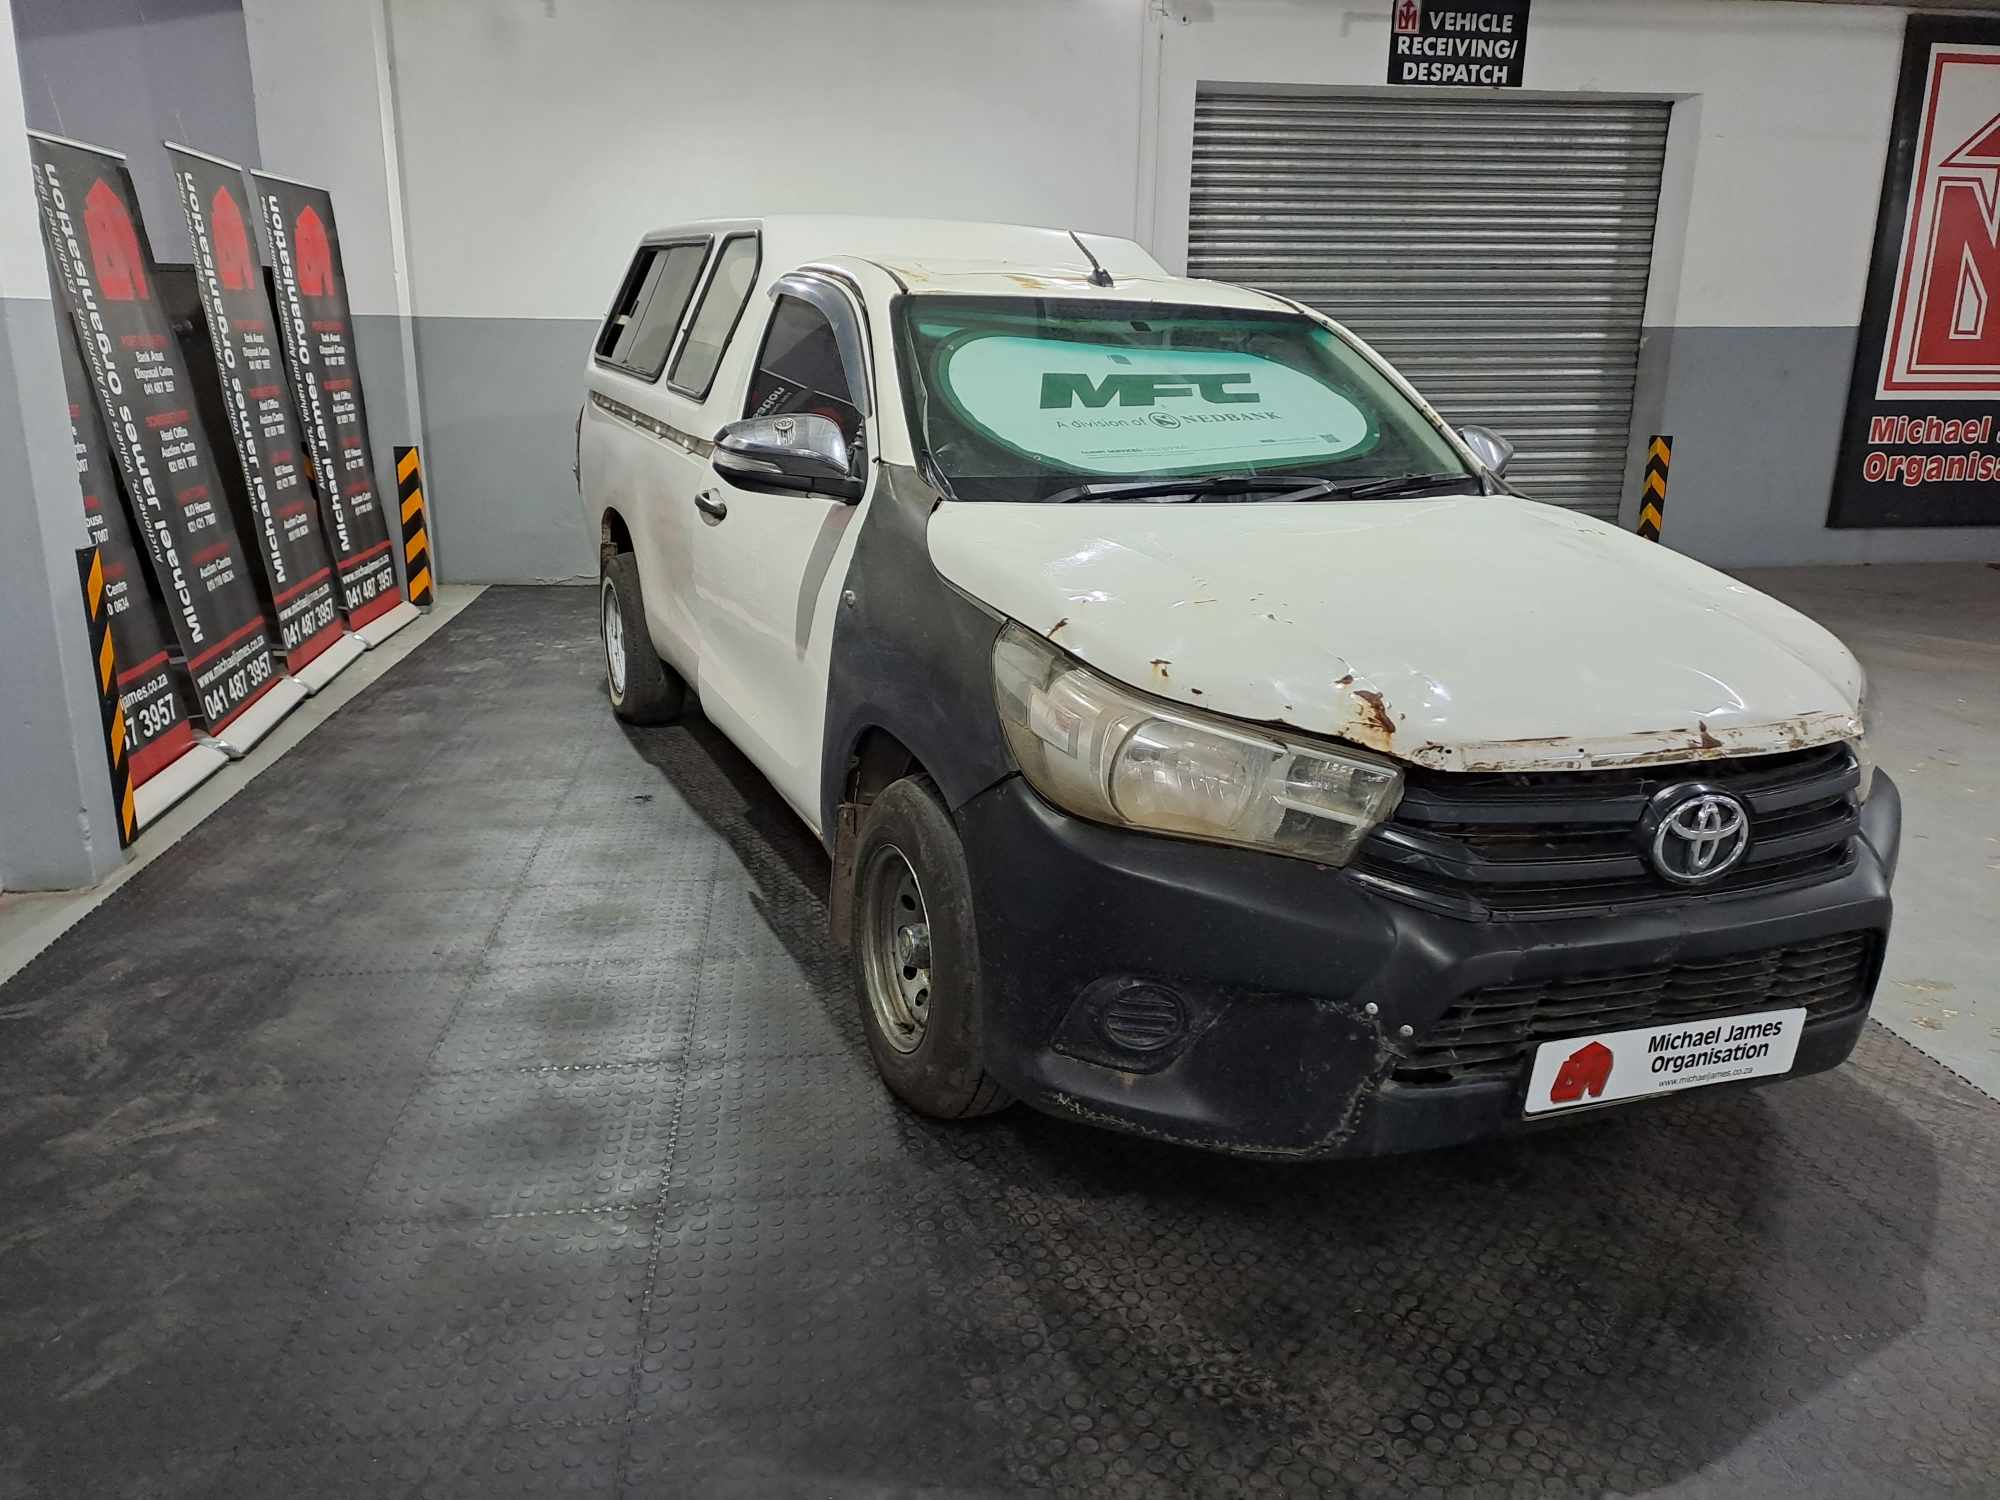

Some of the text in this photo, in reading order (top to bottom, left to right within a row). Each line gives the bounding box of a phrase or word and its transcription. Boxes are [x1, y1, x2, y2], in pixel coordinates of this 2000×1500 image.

[1429, 11, 1514, 33] VEHICLE
[1397, 35, 1519, 60] RECEIVING/
[1402, 61, 1508, 84] DESPATCH
[41, 163, 124, 394] Organisation
[181, 171, 236, 368] Organisation
[266, 195, 311, 364] Organisation
[100, 388, 115, 416] and
[303, 371, 329, 451] James
[1040, 373, 1260, 409] MFC
[230, 377, 260, 469] James
[1071, 417, 1129, 429] division
[1131, 415, 1149, 426] of
[1181, 411, 1281, 424] NEDBANK
[1868, 416, 1992, 444] Michael
[110, 421, 134, 472] Valuers
[117, 405, 161, 512] James
[321, 457, 350, 551] Michael
[252, 476, 286, 583] Michael
[153, 519, 204, 643] Michael
[283, 623, 302, 649] 041
[120, 673, 169, 714] james.co.za
[205, 651, 272, 720] 041 487 3957
[138, 692, 176, 738] 3957
[1648, 1021, 1783, 1053] Michael James
[1651, 1042, 1769, 1073] Organisation
